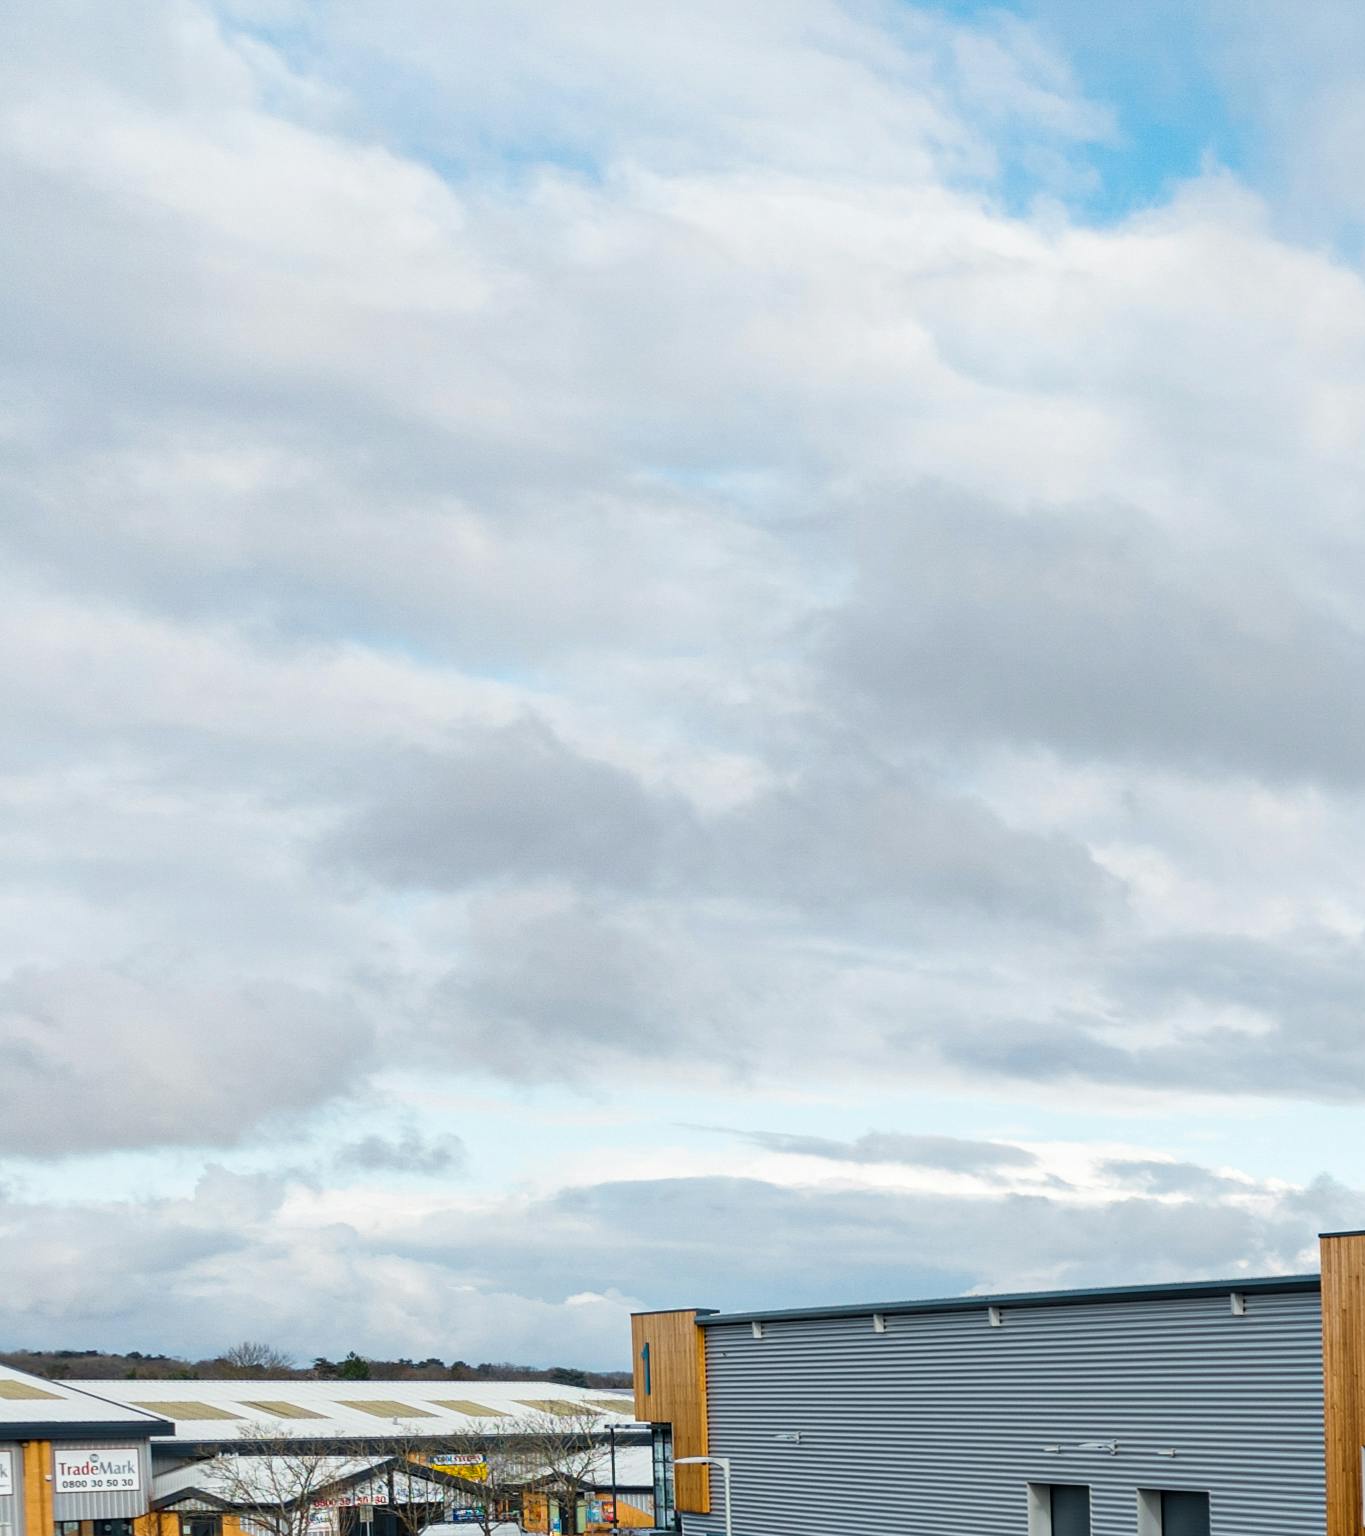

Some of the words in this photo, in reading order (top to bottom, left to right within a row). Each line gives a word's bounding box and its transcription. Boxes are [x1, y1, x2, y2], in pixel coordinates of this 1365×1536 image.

[641, 1343, 651, 1395] 1
[59, 1461, 136, 1476] TradeMark
[62, 1480, 87, 1489] 0800
[91, 1480, 103, 1488] 30
[106, 1479, 119, 1487] 50
[122, 1479, 134, 1487] 30
